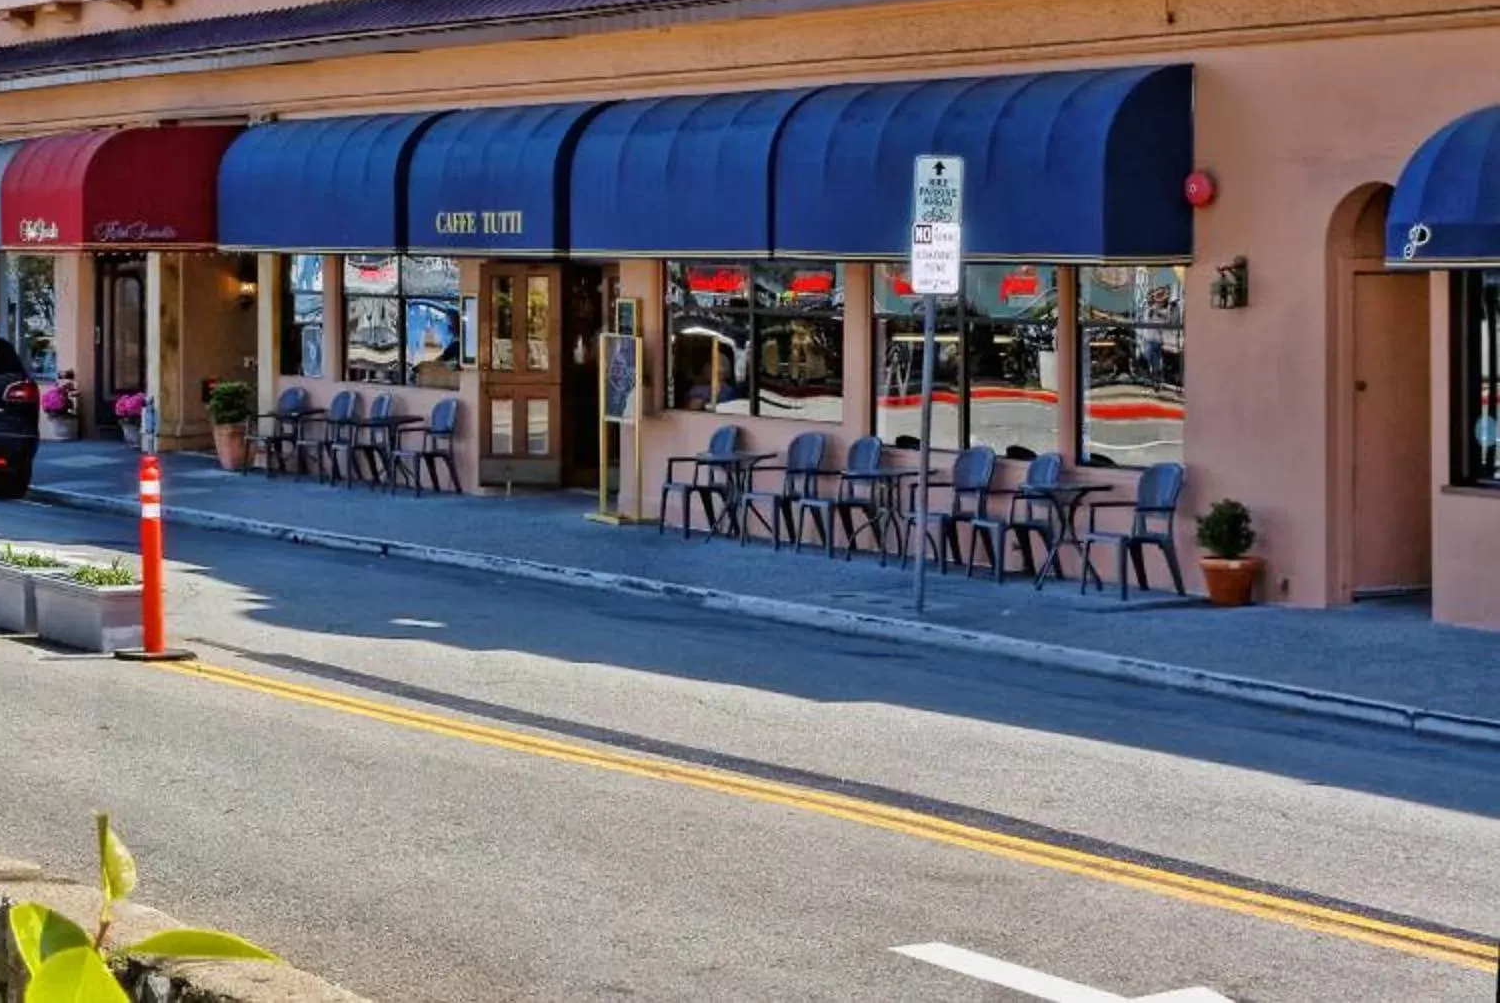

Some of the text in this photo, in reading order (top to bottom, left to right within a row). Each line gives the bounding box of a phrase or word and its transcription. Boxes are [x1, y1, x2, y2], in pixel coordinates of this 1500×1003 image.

[435, 211, 523, 234] CAFFE TUTTI
[915, 226, 931, 243] NO
